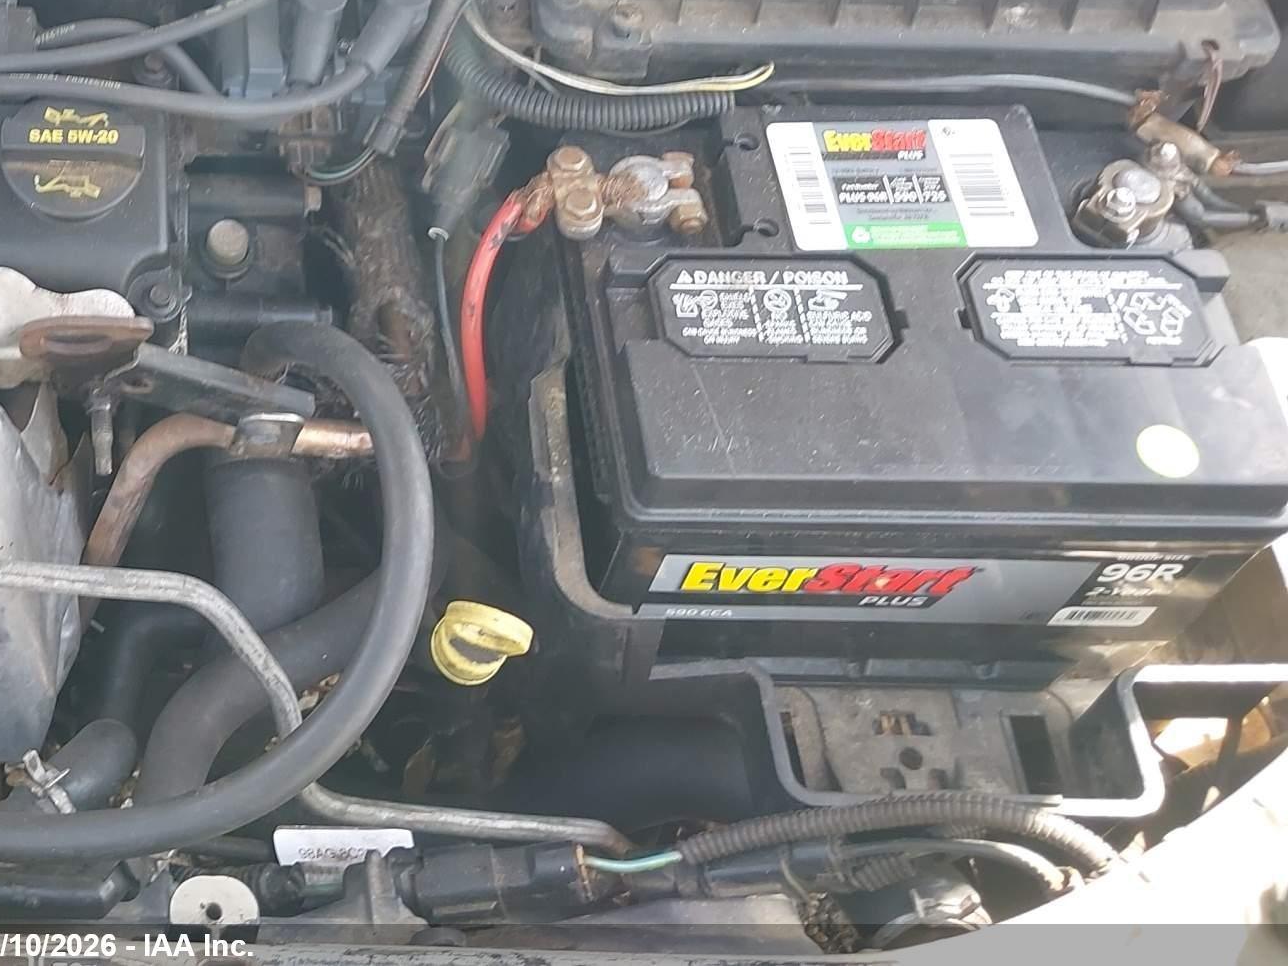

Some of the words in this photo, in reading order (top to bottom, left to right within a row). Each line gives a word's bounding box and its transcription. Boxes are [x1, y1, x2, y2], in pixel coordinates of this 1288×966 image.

[28, 128, 63, 144] SAE
[67, 128, 120, 145] 5W-20
[823, 128, 926, 152] EverStart
[897, 149, 924, 161] PLUS
[693, 270, 766, 285] DANGER
[782, 270, 849, 285] POISON
[679, 562, 978, 594] EverStart
[1096, 563, 1184, 583] 96R
[859, 595, 928, 607] PLUS
[665, 608, 697, 617] 590
